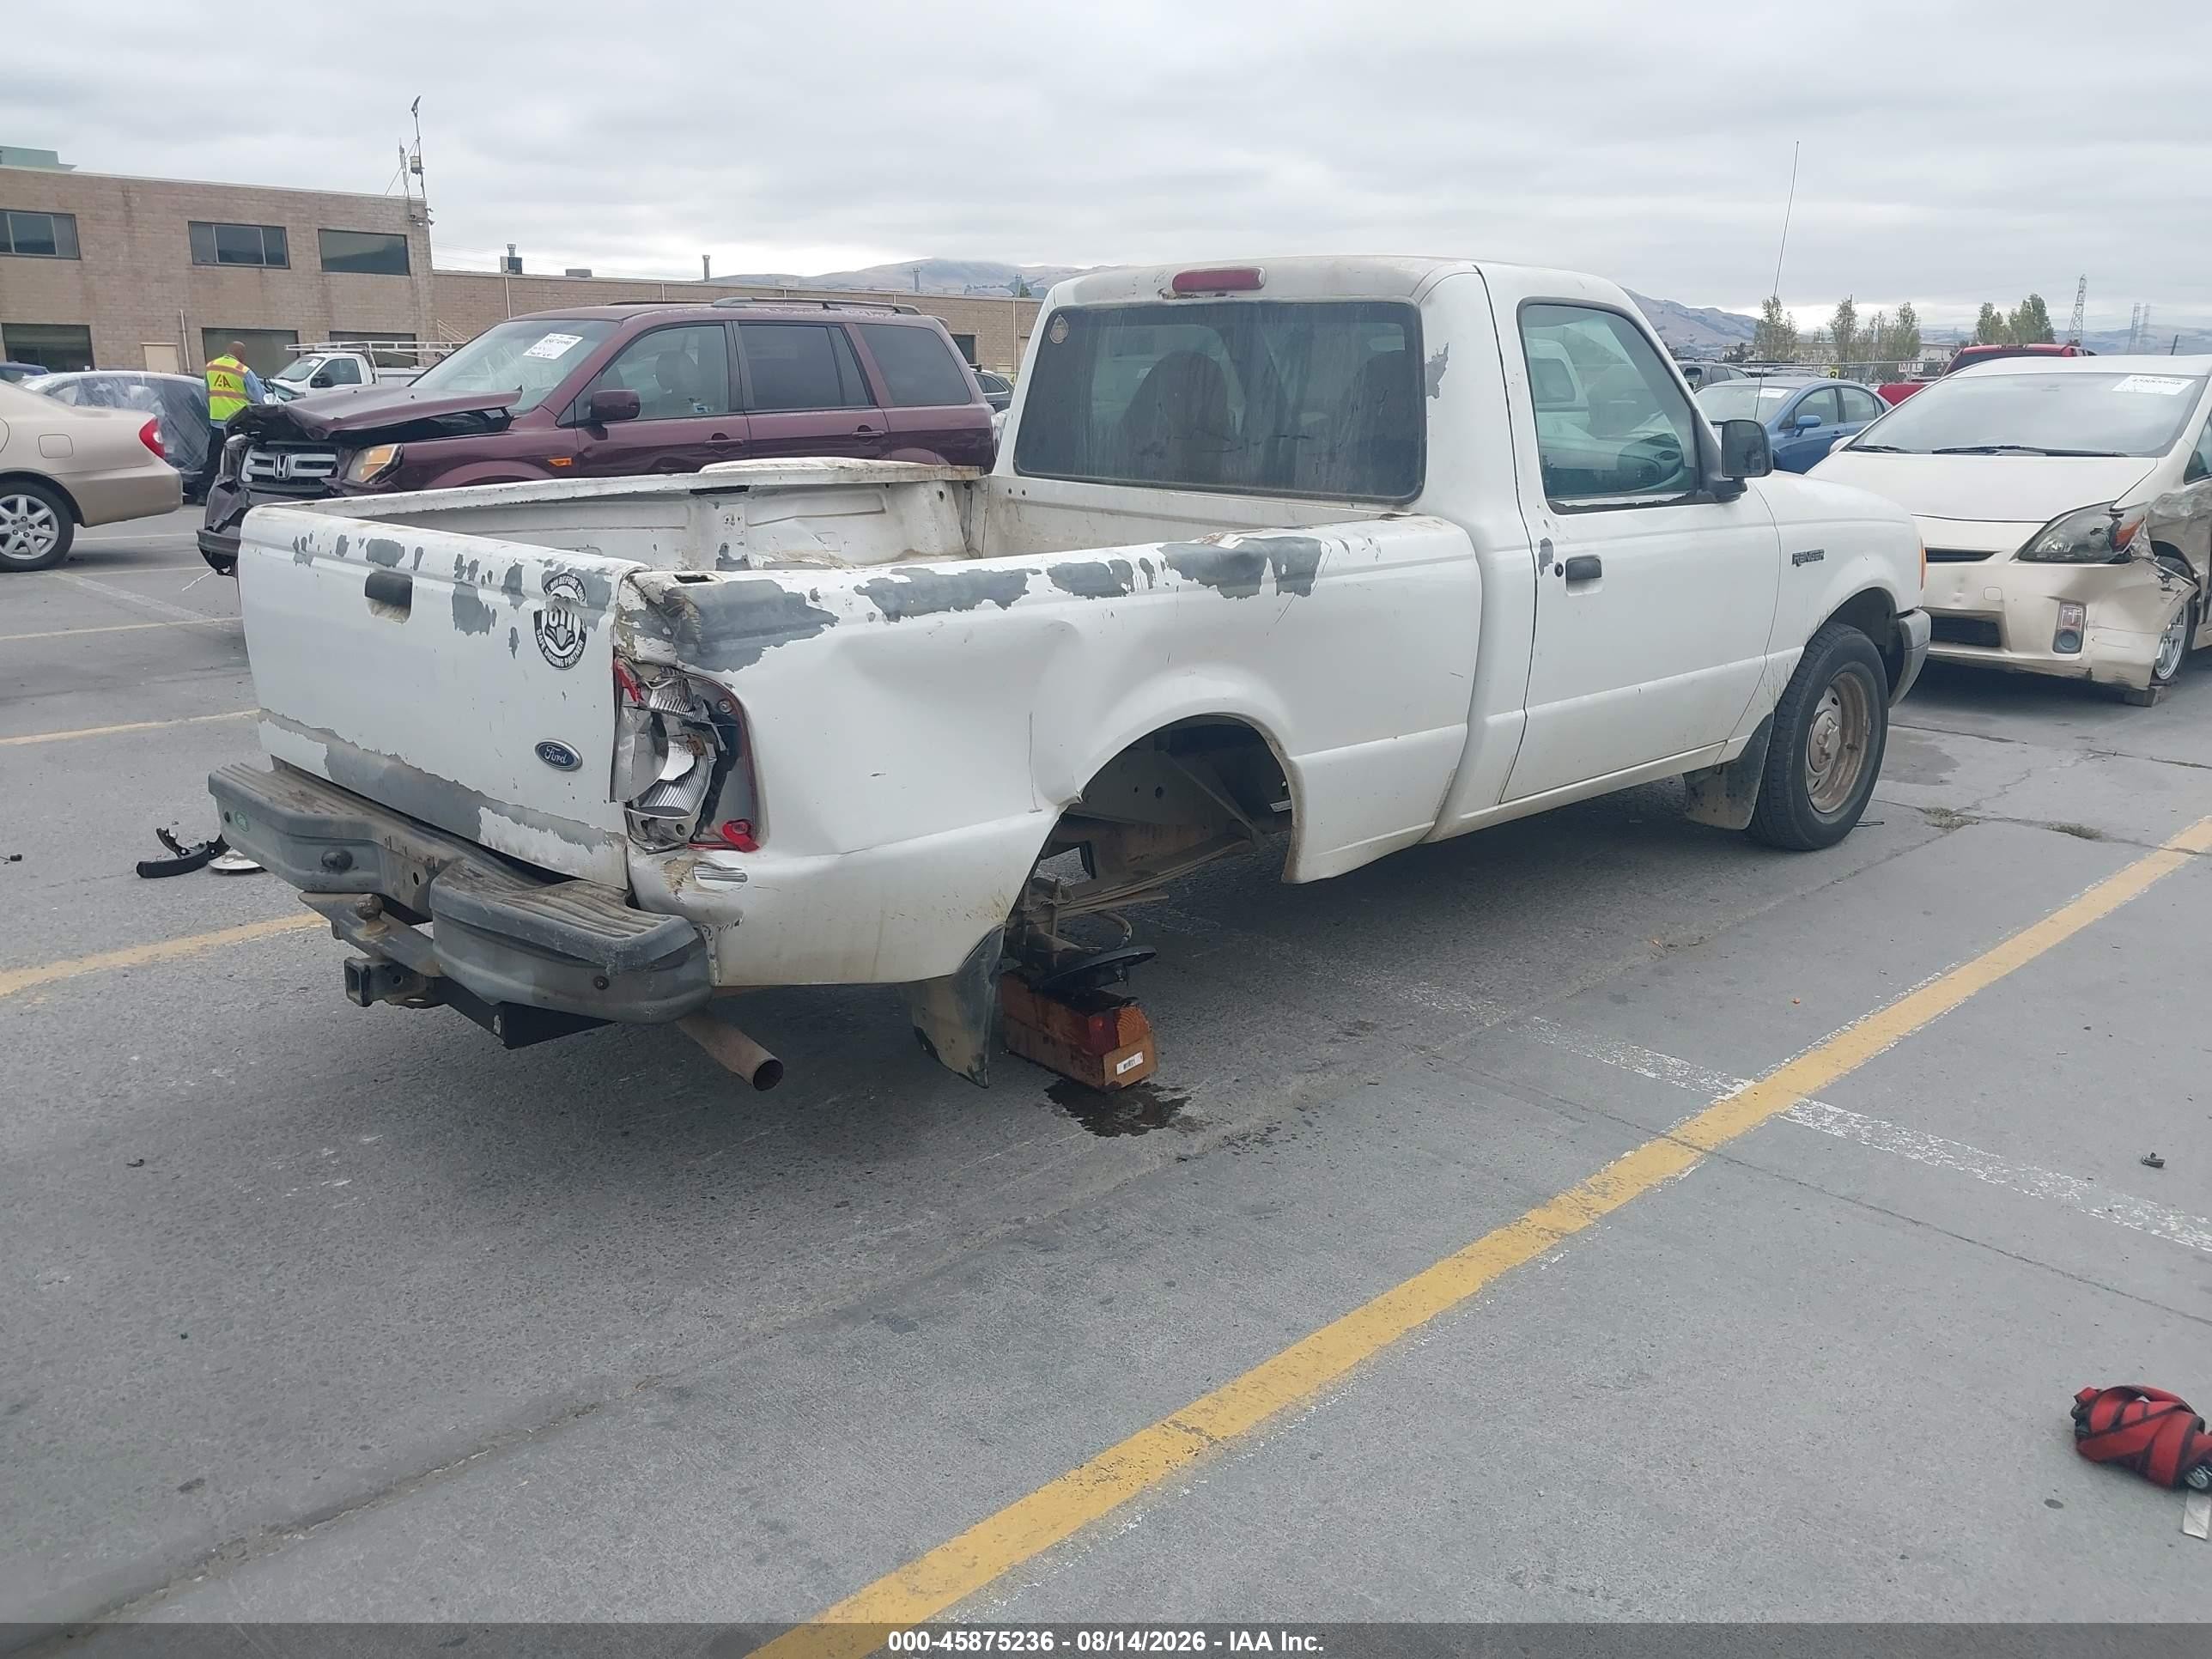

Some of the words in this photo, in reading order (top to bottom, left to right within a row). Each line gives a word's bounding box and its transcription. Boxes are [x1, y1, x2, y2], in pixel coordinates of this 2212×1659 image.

[559, 576, 579, 589] BEFORE
[537, 629, 547, 651] SAFE
[544, 647, 564, 666] DIGGING
[564, 640, 584, 666] PARTNER
[545, 746, 567, 763] Ford
